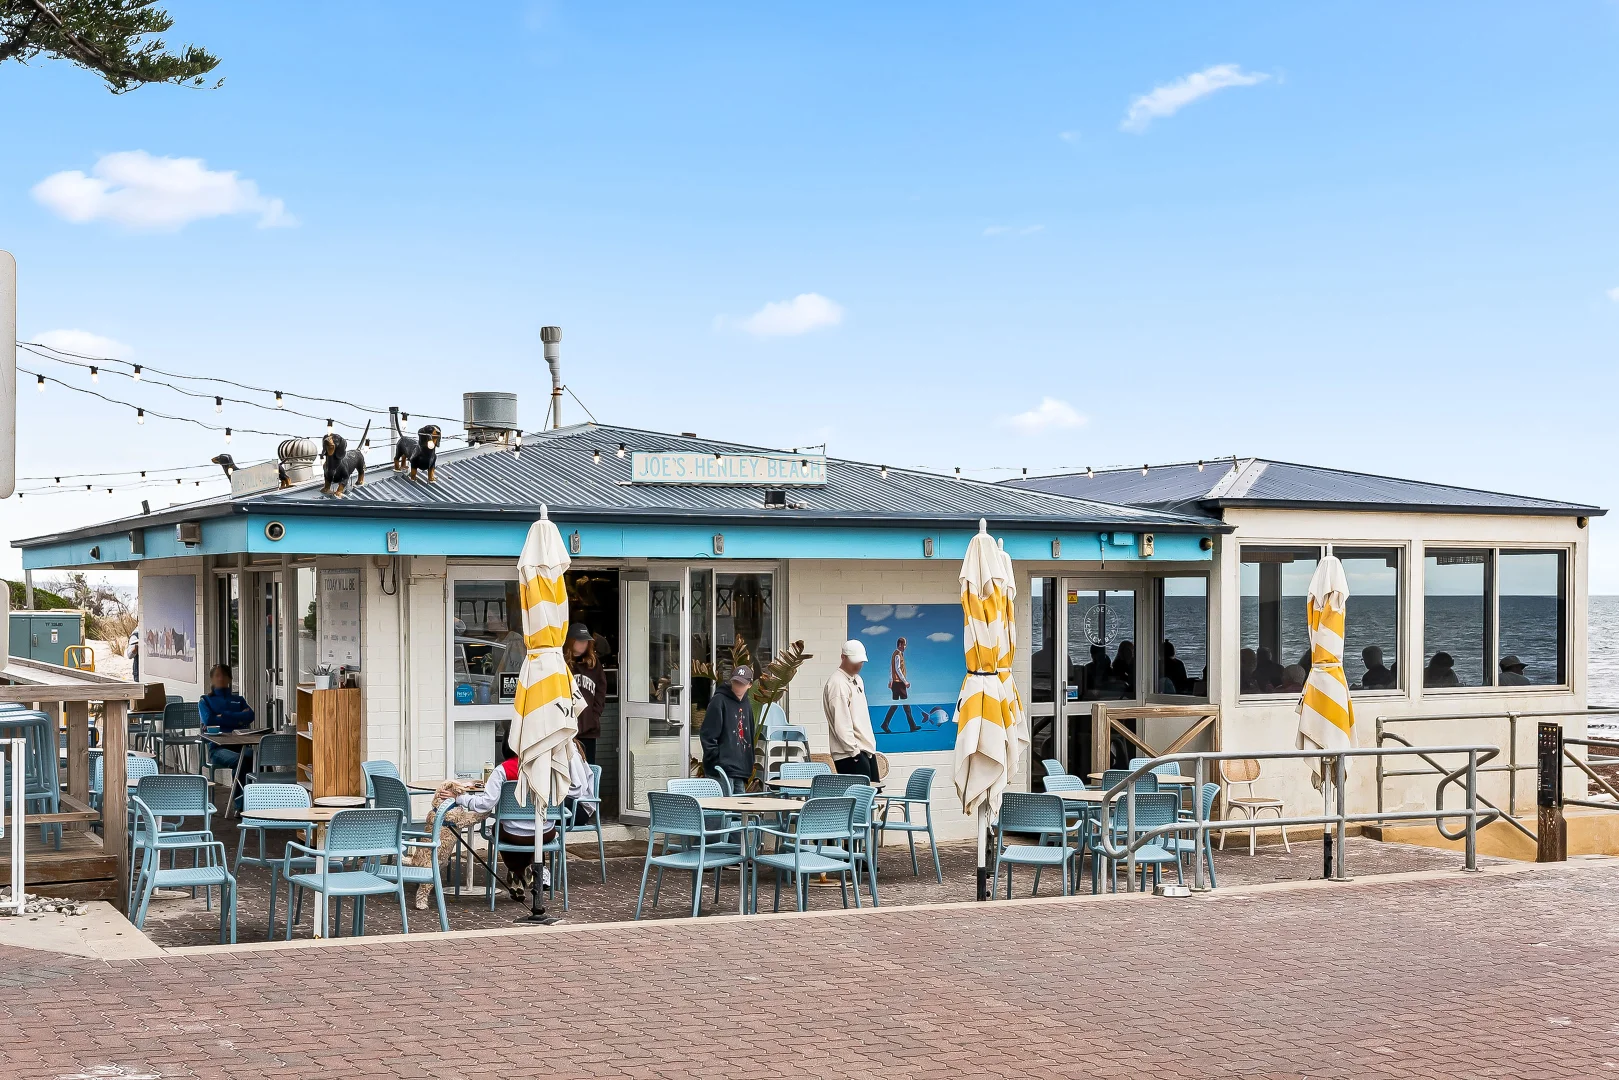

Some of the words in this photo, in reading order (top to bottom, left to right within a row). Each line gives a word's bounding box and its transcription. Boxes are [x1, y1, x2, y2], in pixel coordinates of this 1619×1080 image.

[639, 456, 686, 477] JOE'S
[695, 457, 759, 478] HENLEY
[767, 459, 821, 479] BEACH
[325, 579, 338, 591] TODAY
[349, 578, 355, 590] BE
